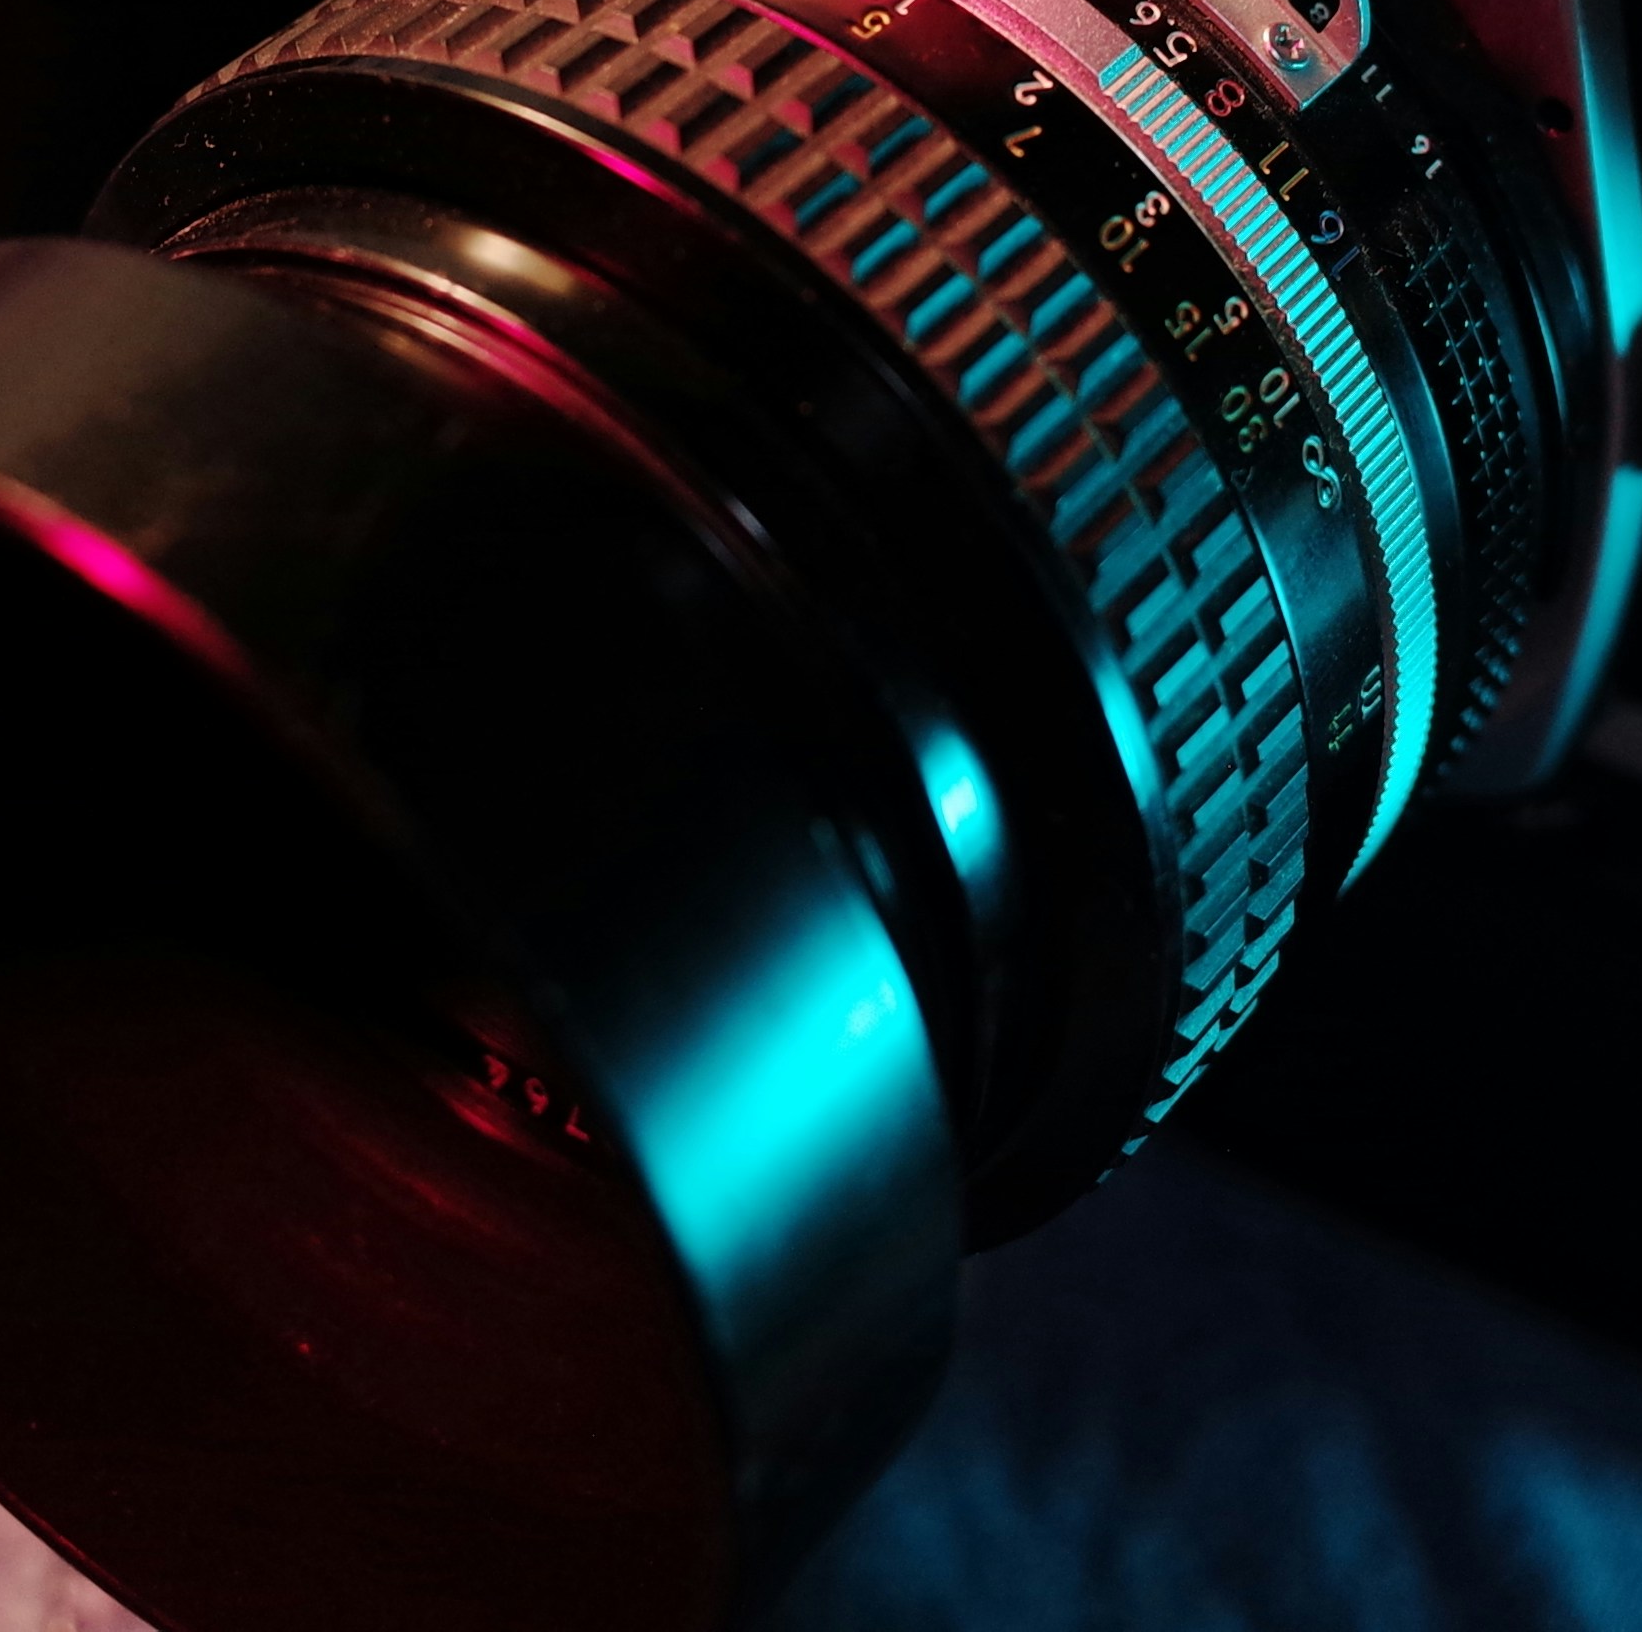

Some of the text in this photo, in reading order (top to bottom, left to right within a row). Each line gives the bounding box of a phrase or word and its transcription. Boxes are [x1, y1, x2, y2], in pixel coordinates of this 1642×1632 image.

[850, 9, 891, 40] 5
[1003, 124, 1043, 159] 7
[1098, 214, 1151, 274] 10
[1163, 299, 1214, 363] 15
[1220, 384, 1270, 455] 30
[1013, 69, 1055, 108] 2
[1133, 189, 1172, 230] 3
[1211, 295, 1250, 336] 5
[1258, 366, 1302, 430] 10
[1127, 0, 1198, 70] 5.6
[1203, 77, 1246, 118] 8
[1258, 140, 1310, 204] 11
[1308, 209, 1362, 280] 16
[1309, 1, 1332, 25] 8
[1360, 62, 1395, 105] 11
[1409, 133, 1444, 181] 16
